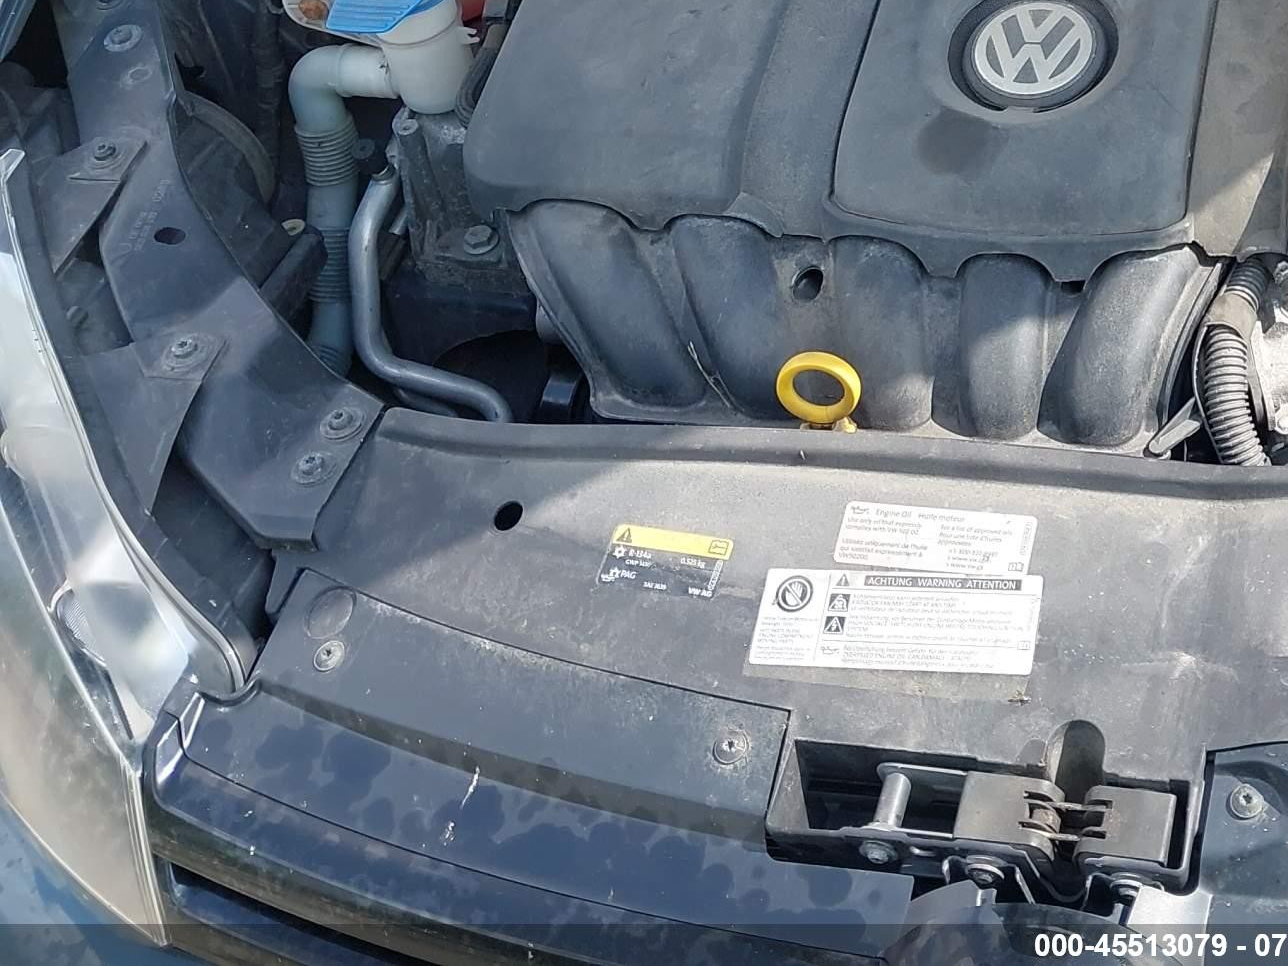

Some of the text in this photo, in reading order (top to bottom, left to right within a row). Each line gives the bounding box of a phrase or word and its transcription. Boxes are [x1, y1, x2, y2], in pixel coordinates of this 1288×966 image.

[974, 0, 1094, 95] VW
[875, 508, 900, 518] Engine
[620, 569, 637, 580] PAG
[867, 576, 1016, 590] ACHTUNG WARNING ATTENTION
[688, 587, 713, 598] VW AG
